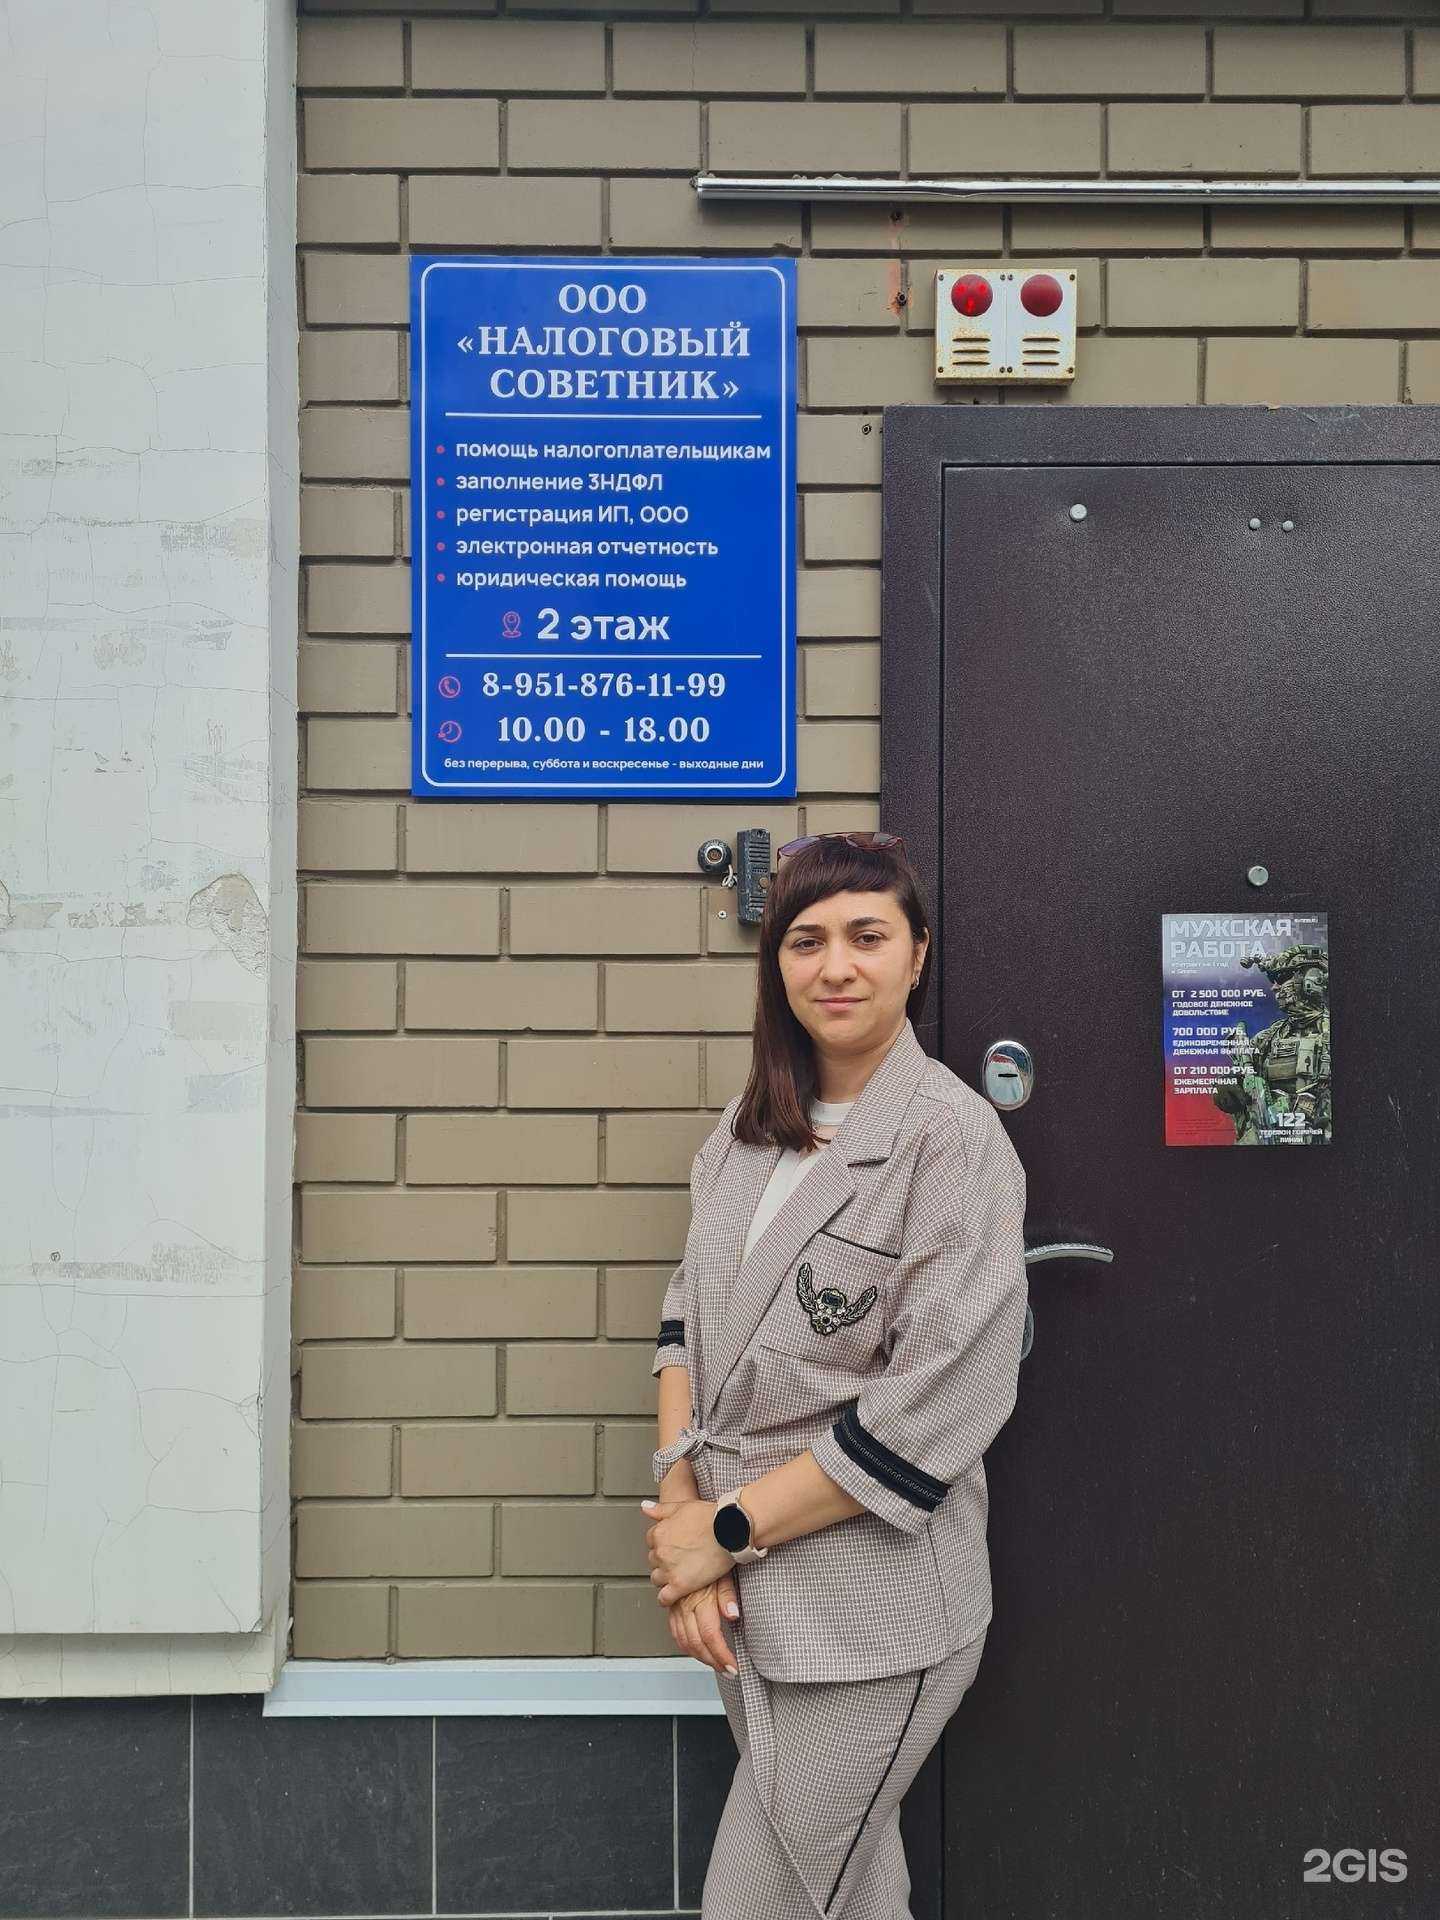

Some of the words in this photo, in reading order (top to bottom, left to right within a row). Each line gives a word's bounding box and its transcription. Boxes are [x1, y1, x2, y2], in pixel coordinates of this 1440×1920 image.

[558, 283, 647, 314] ООО
[456, 320, 751, 357] «НАЛОГОВЫЙ
[489, 368, 740, 400] СОВЕТНИК»
[456, 443, 539, 460] помощь
[543, 444, 771, 461] налогоплательщикам
[455, 475, 584, 491] заполнение
[456, 507, 593, 527] регистрация
[598, 505, 634, 525] ИП,
[639, 505, 689, 524] ООО
[455, 540, 593, 560] электронная
[597, 541, 719, 556] отчетность
[456, 572, 600, 591] юридическая
[605, 573, 687, 589] помощь
[537, 607, 560, 640] 2
[570, 614, 671, 641] этаж
[482, 672, 726, 697] 8-951-876-11-99
[498, 716, 586, 743] 10.00
[624, 716, 710, 743] 18.00
[444, 757, 466, 768] без
[467, 759, 530, 771] перерыва,
[532, 758, 581, 771] суббота
[582, 760, 590, 768] и
[592, 760, 670, 771] воскресенье
[679, 760, 739, 770] выходные
[741, 760, 764, 770] дни
[1170, 918, 1292, 937] МУЖСКАЯ
[1170, 940, 1267, 959] РАБОТА
[1172, 990, 1186, 998] ОТ
[1190, 990, 1198, 998] 2
[1198, 990, 1218, 998] 500
[1221, 990, 1241, 998] 000
[1243, 989, 1267, 998] РУБ.
[1172, 1009, 1229, 1017] ДОВОЛЬСТВИЕ
[1172, 1028, 1193, 1036] 700
[1196, 1027, 1218, 1036] 000
[1221, 1027, 1247, 1036] РУБ.
[1172, 1048, 1220, 1056] ДЕНЕЖНАЯ
[1174, 1067, 1188, 1075] ОТ
[1190, 1067, 1207, 1075] 210
[1210, 1067, 1231, 1075] 000
[1232, 1067, 1258, 1075] РУБ.
[1173, 1087, 1219, 1095] ЗАРПЛАТА
[1276, 1112, 1306, 1127] 122
